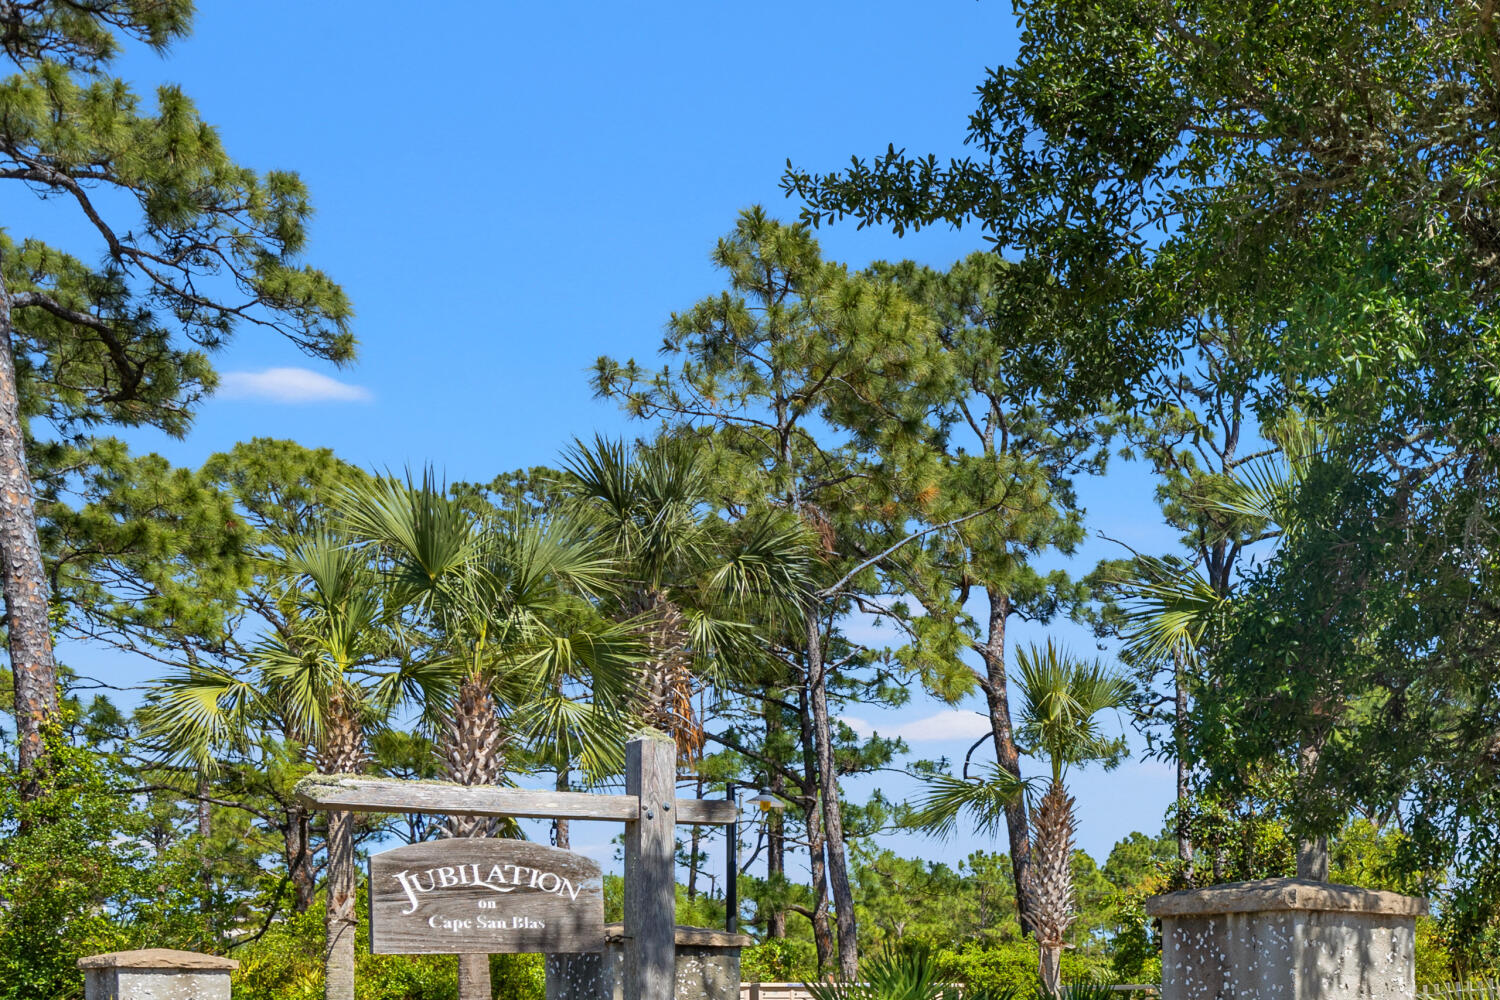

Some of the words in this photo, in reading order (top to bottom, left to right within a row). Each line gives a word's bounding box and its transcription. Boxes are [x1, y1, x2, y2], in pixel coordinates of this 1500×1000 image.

[392, 863, 583, 915] JUBILATION
[478, 900, 496, 909] on
[428, 915, 472, 932] Cape
[476, 914, 507, 929] San
[512, 916, 546, 929] Blas
